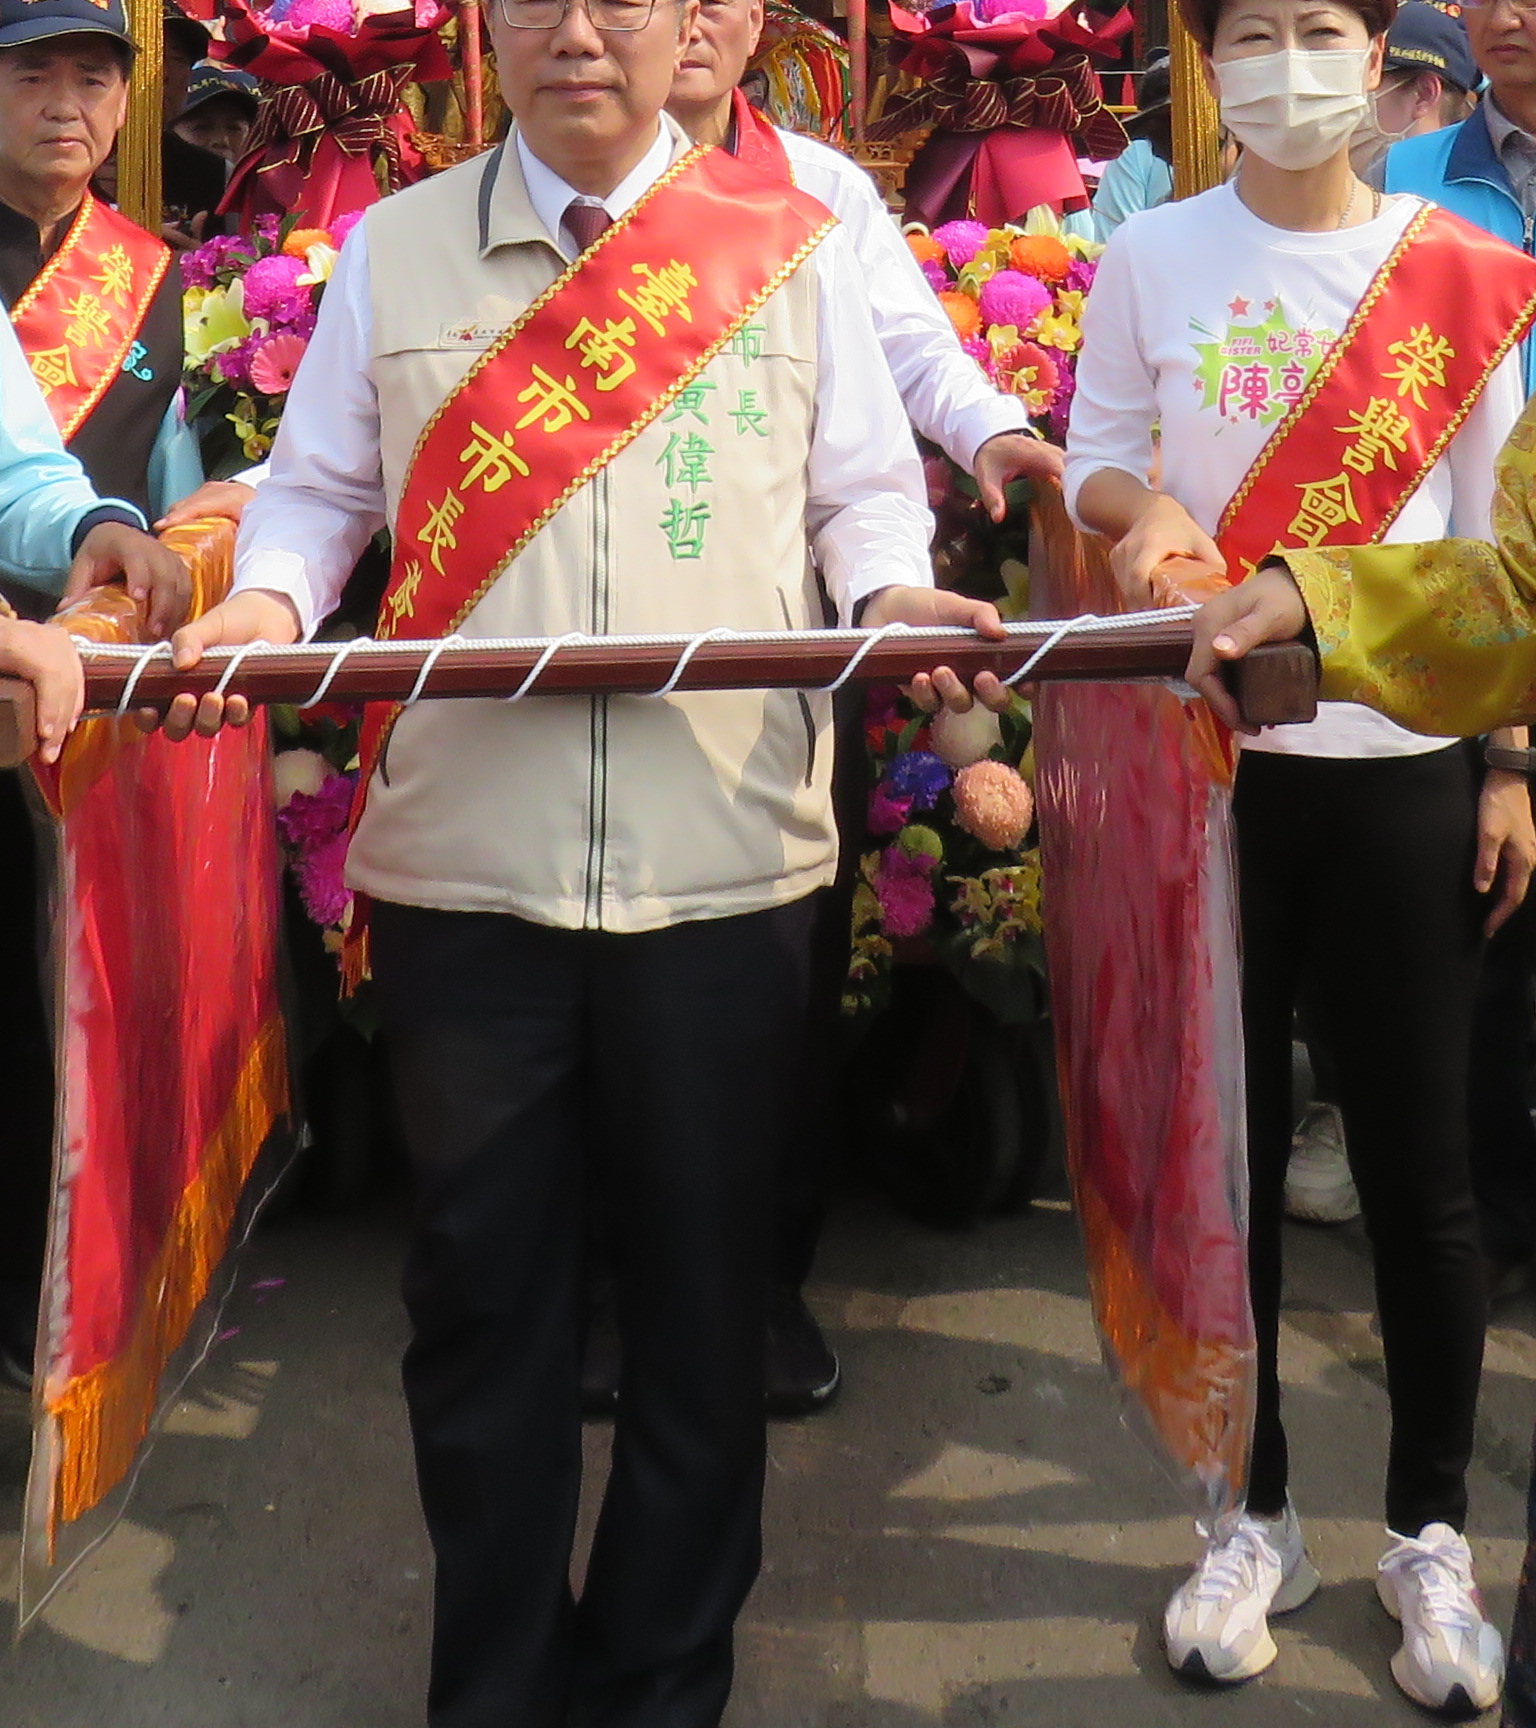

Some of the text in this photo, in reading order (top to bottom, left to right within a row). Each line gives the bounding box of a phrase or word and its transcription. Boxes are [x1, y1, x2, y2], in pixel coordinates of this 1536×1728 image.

[727, 323, 769, 437] 市長
[1231, 338, 1254, 348] FIFI
[1238, 322, 1456, 583] 榮譽會
